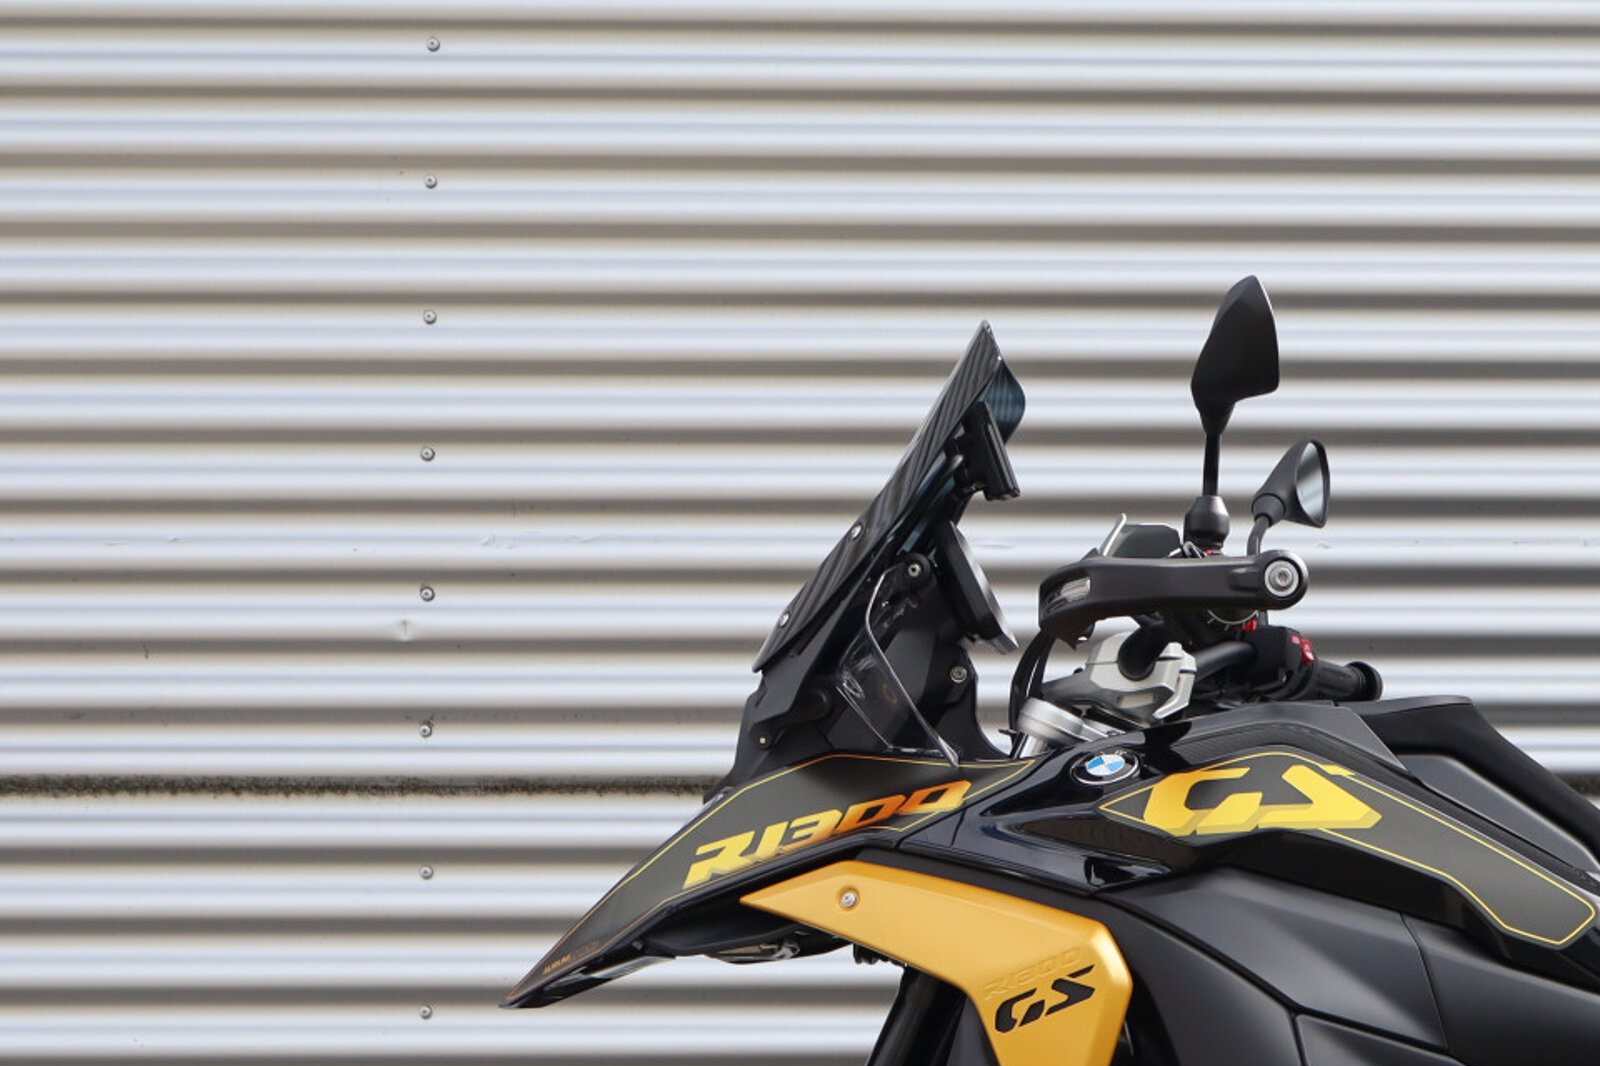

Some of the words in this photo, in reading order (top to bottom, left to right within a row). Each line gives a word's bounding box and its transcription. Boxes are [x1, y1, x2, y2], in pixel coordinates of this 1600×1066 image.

[682, 780, 972, 889] R1300
[1143, 765, 1382, 837] GS
[995, 964, 1095, 1033] GS
